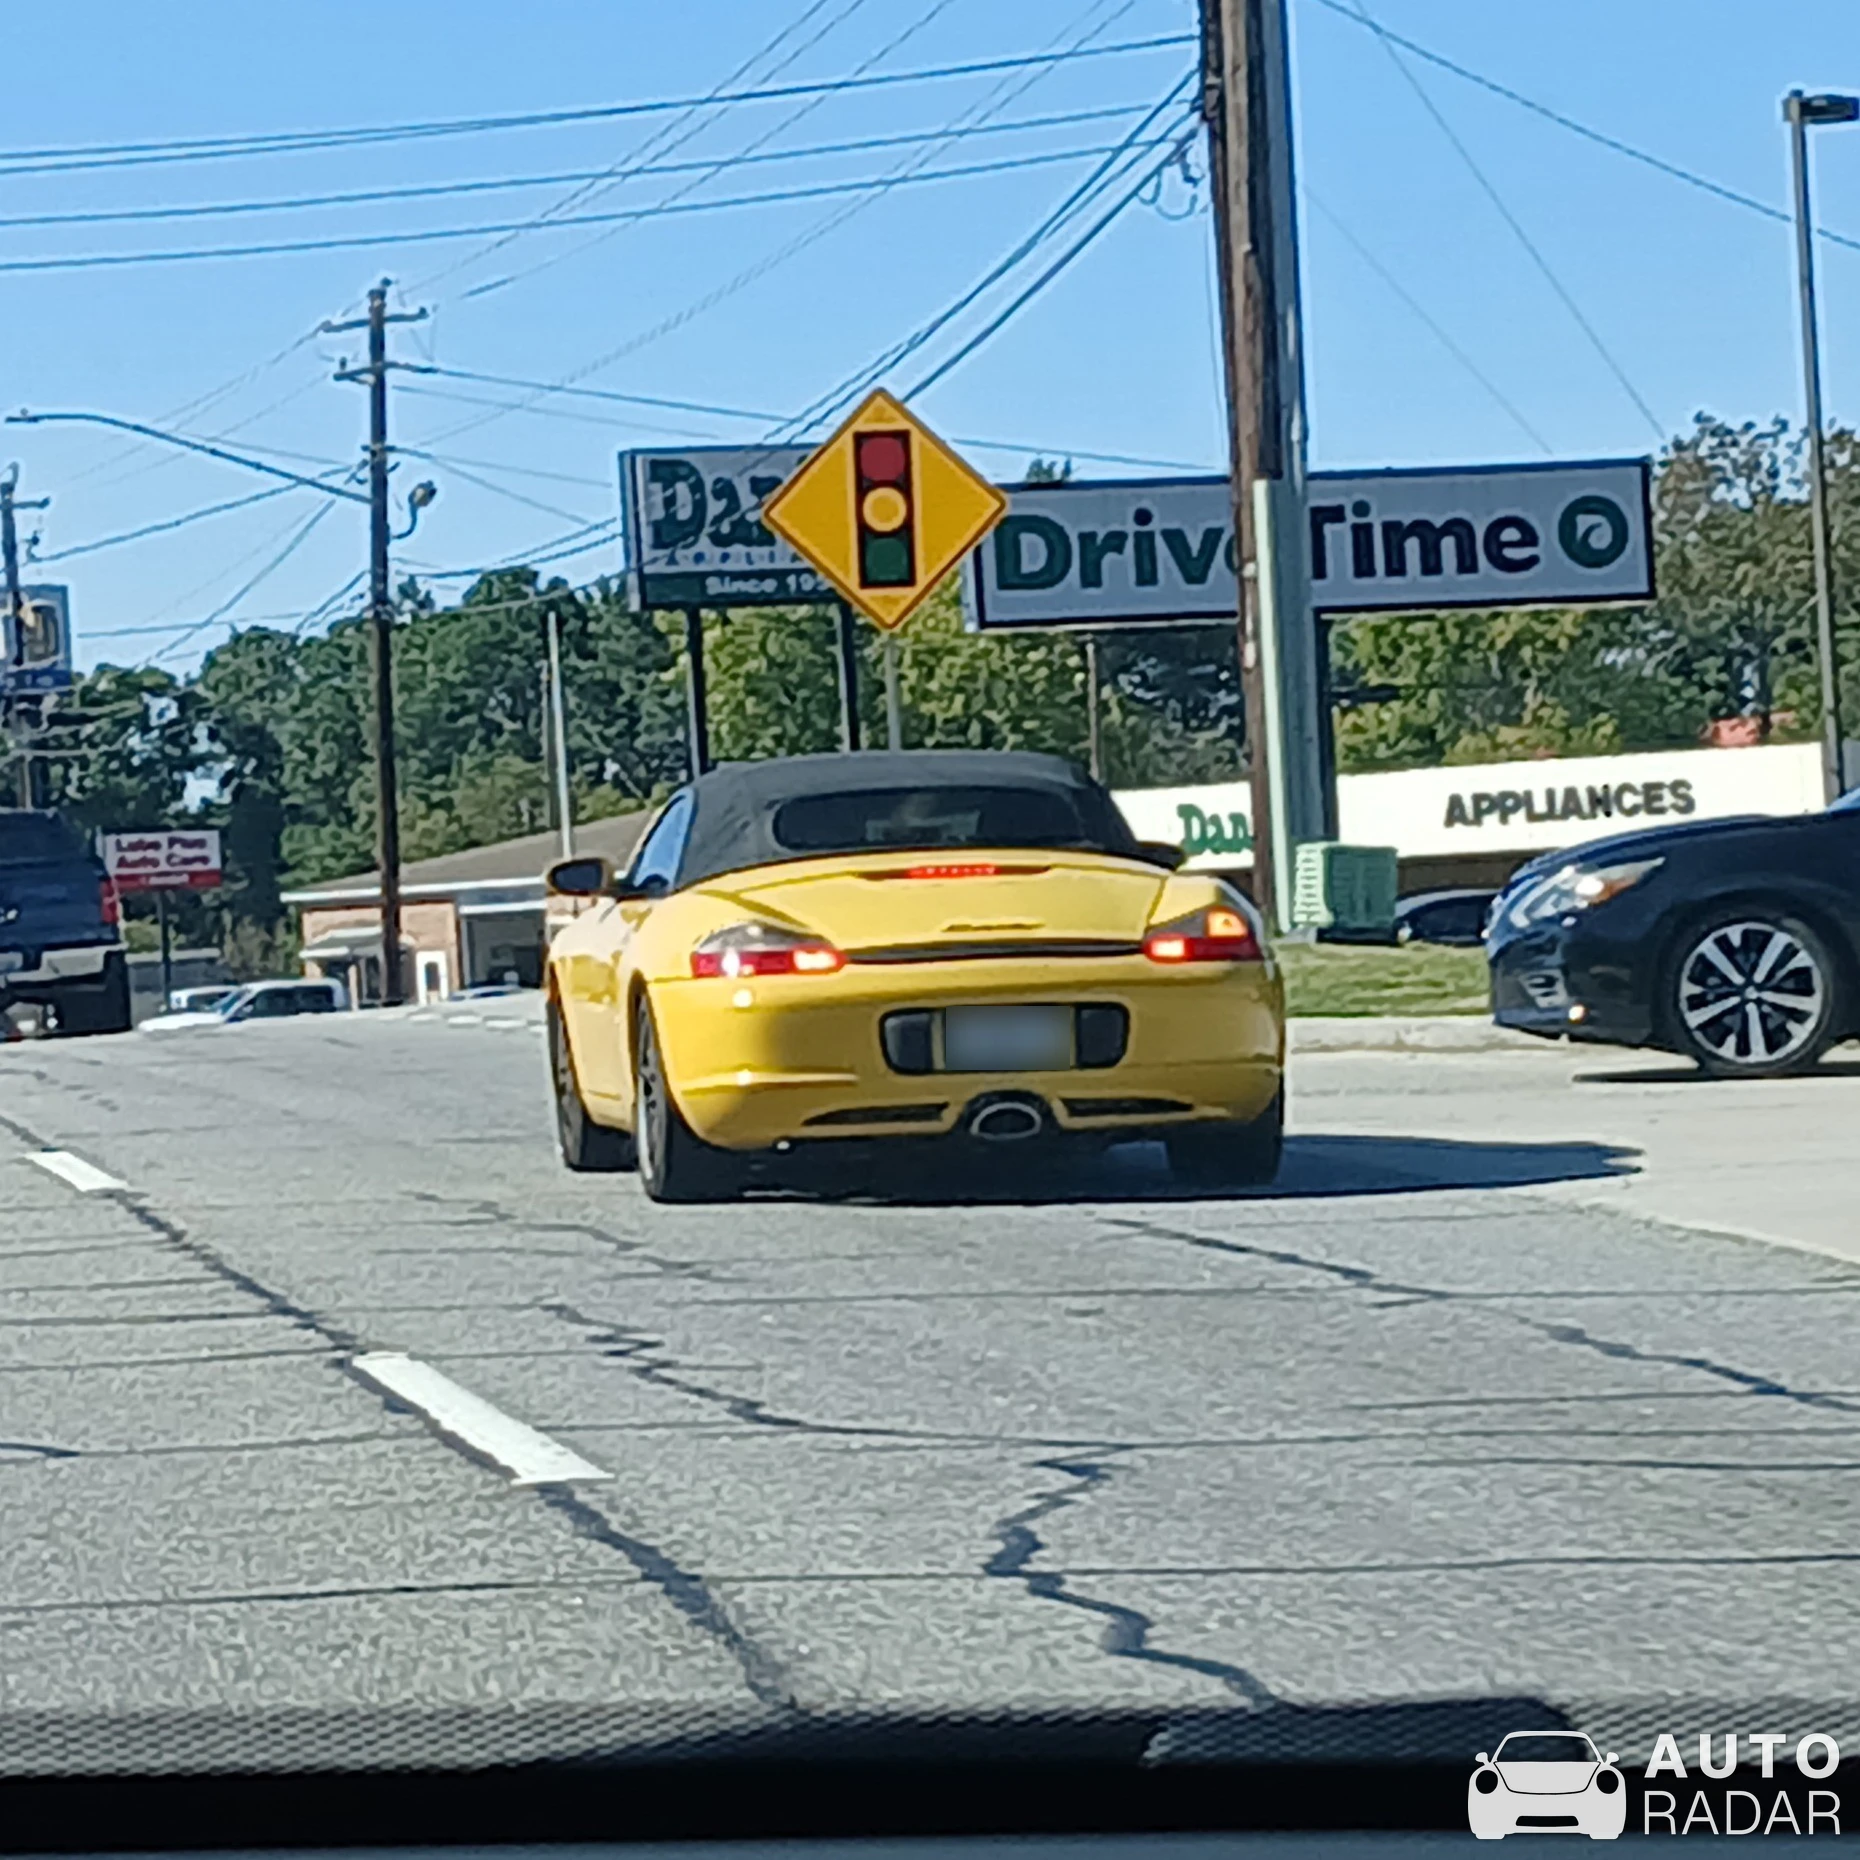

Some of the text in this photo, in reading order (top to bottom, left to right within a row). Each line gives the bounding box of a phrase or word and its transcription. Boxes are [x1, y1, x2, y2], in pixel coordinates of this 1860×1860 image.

[993, 499, 1540, 591] DrivTime
[705, 575, 777, 595] Since
[1444, 779, 1696, 828] APPLIANCES
